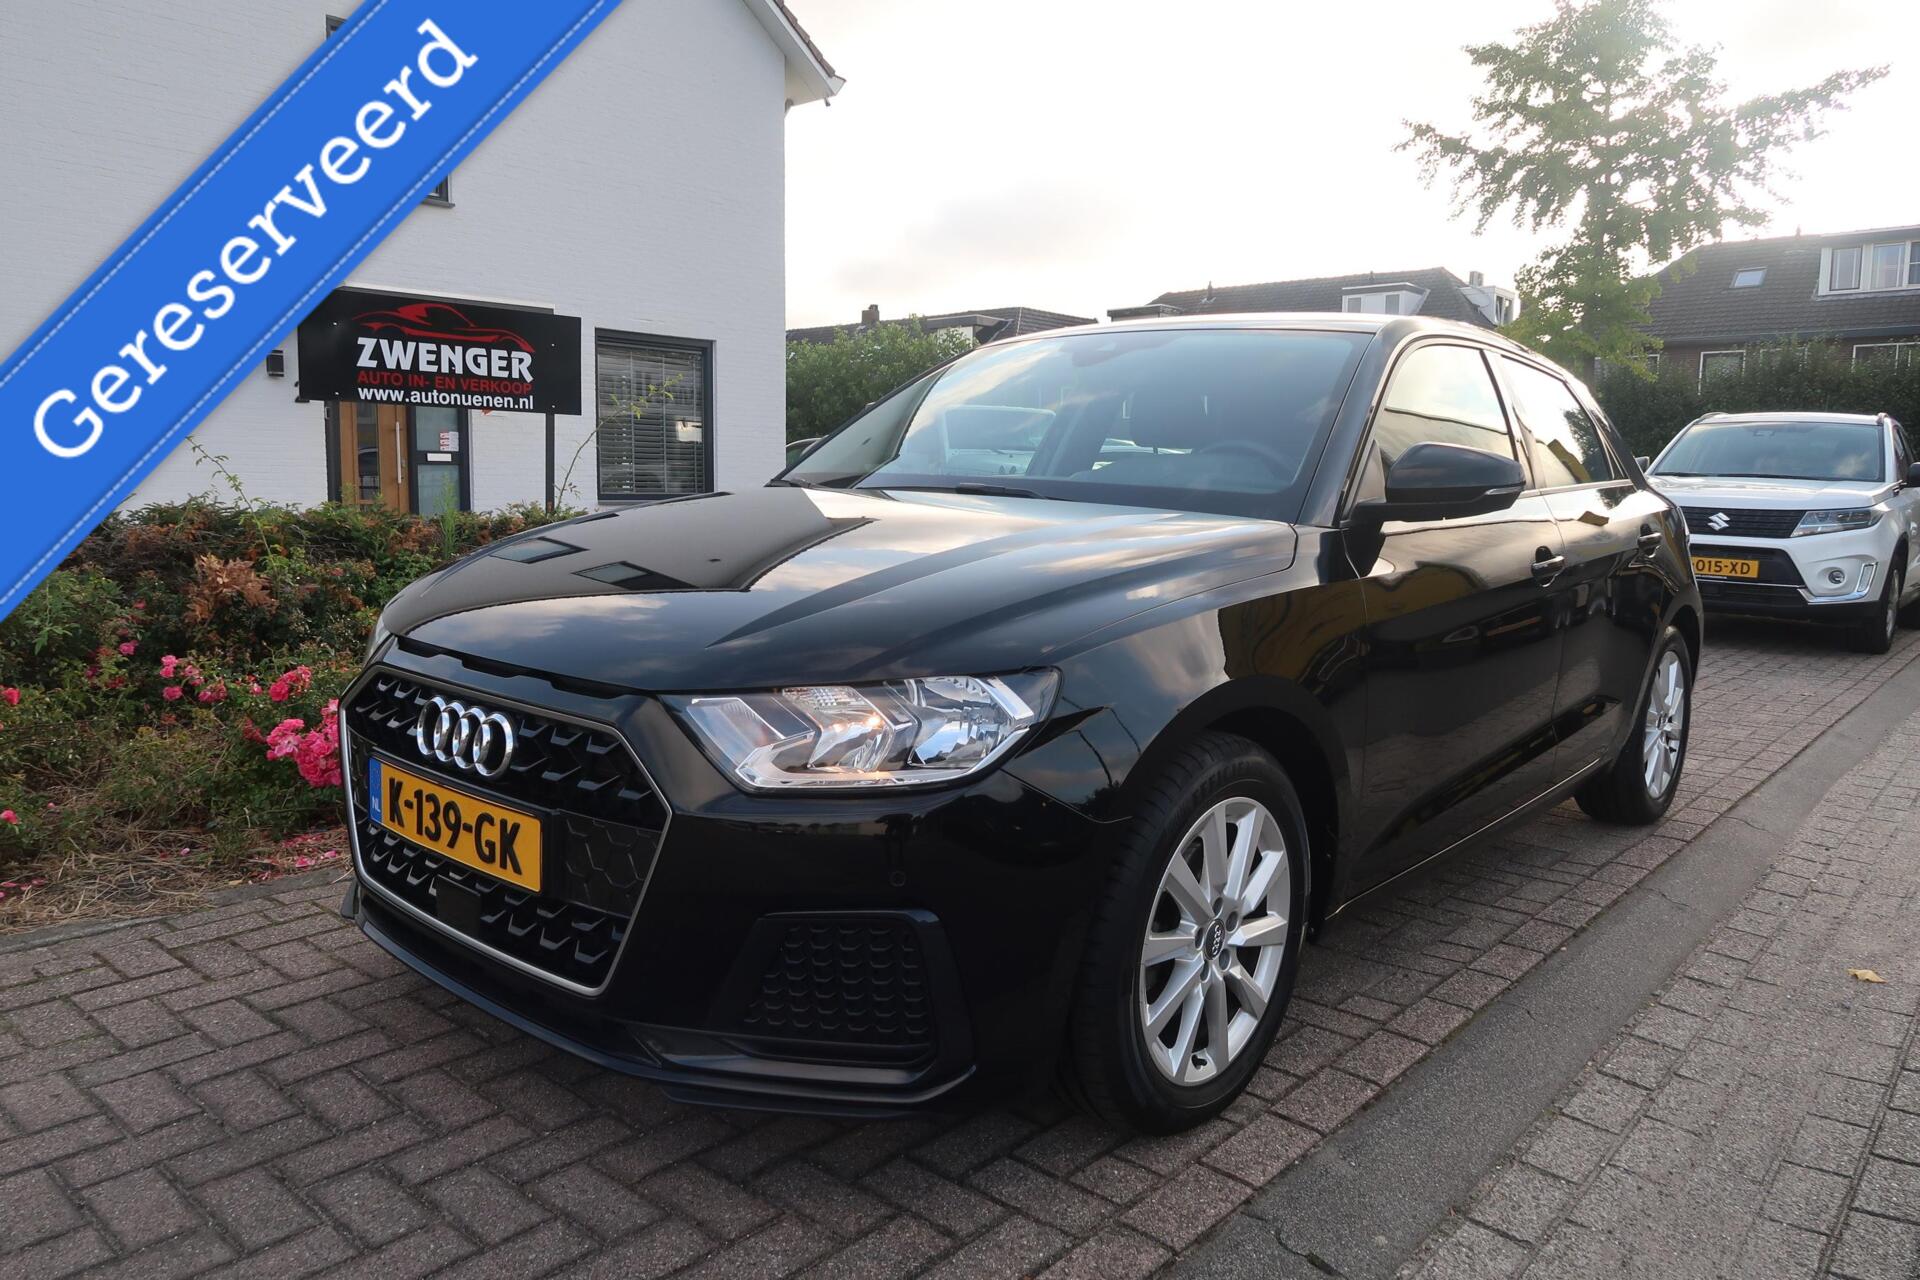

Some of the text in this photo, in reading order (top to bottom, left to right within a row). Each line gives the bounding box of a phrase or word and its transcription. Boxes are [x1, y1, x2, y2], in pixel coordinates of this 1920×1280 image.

[356, 336, 535, 383] ZWENGER
[357, 370, 533, 395] AUTO IN- EN VERKOOP
[357, 387, 534, 410] www.autonuenen.nl
[1693, 559, 1751, 575] 015-XD
[388, 777, 523, 876] K-139-GK
